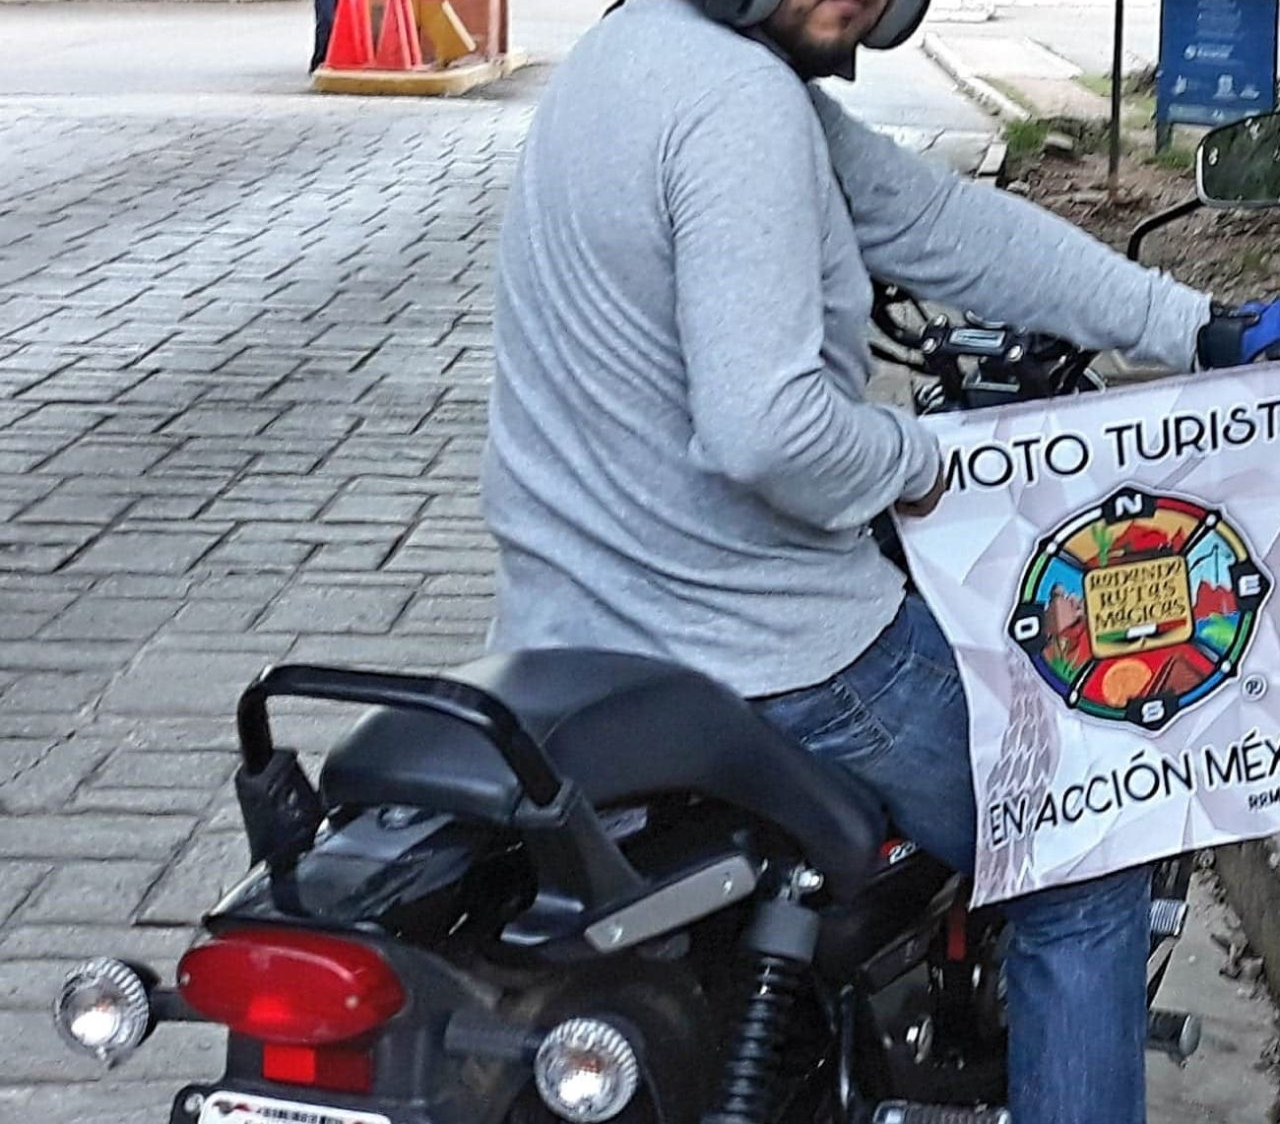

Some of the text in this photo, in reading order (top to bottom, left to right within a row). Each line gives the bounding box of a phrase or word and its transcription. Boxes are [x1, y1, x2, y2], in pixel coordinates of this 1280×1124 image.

[1114, 495, 1144, 517] N
[1239, 573, 1263, 596] E
[1142, 701, 1166, 723] S
[990, 798, 1032, 848] EN
[1034, 751, 1193, 830] ACCIÓN
